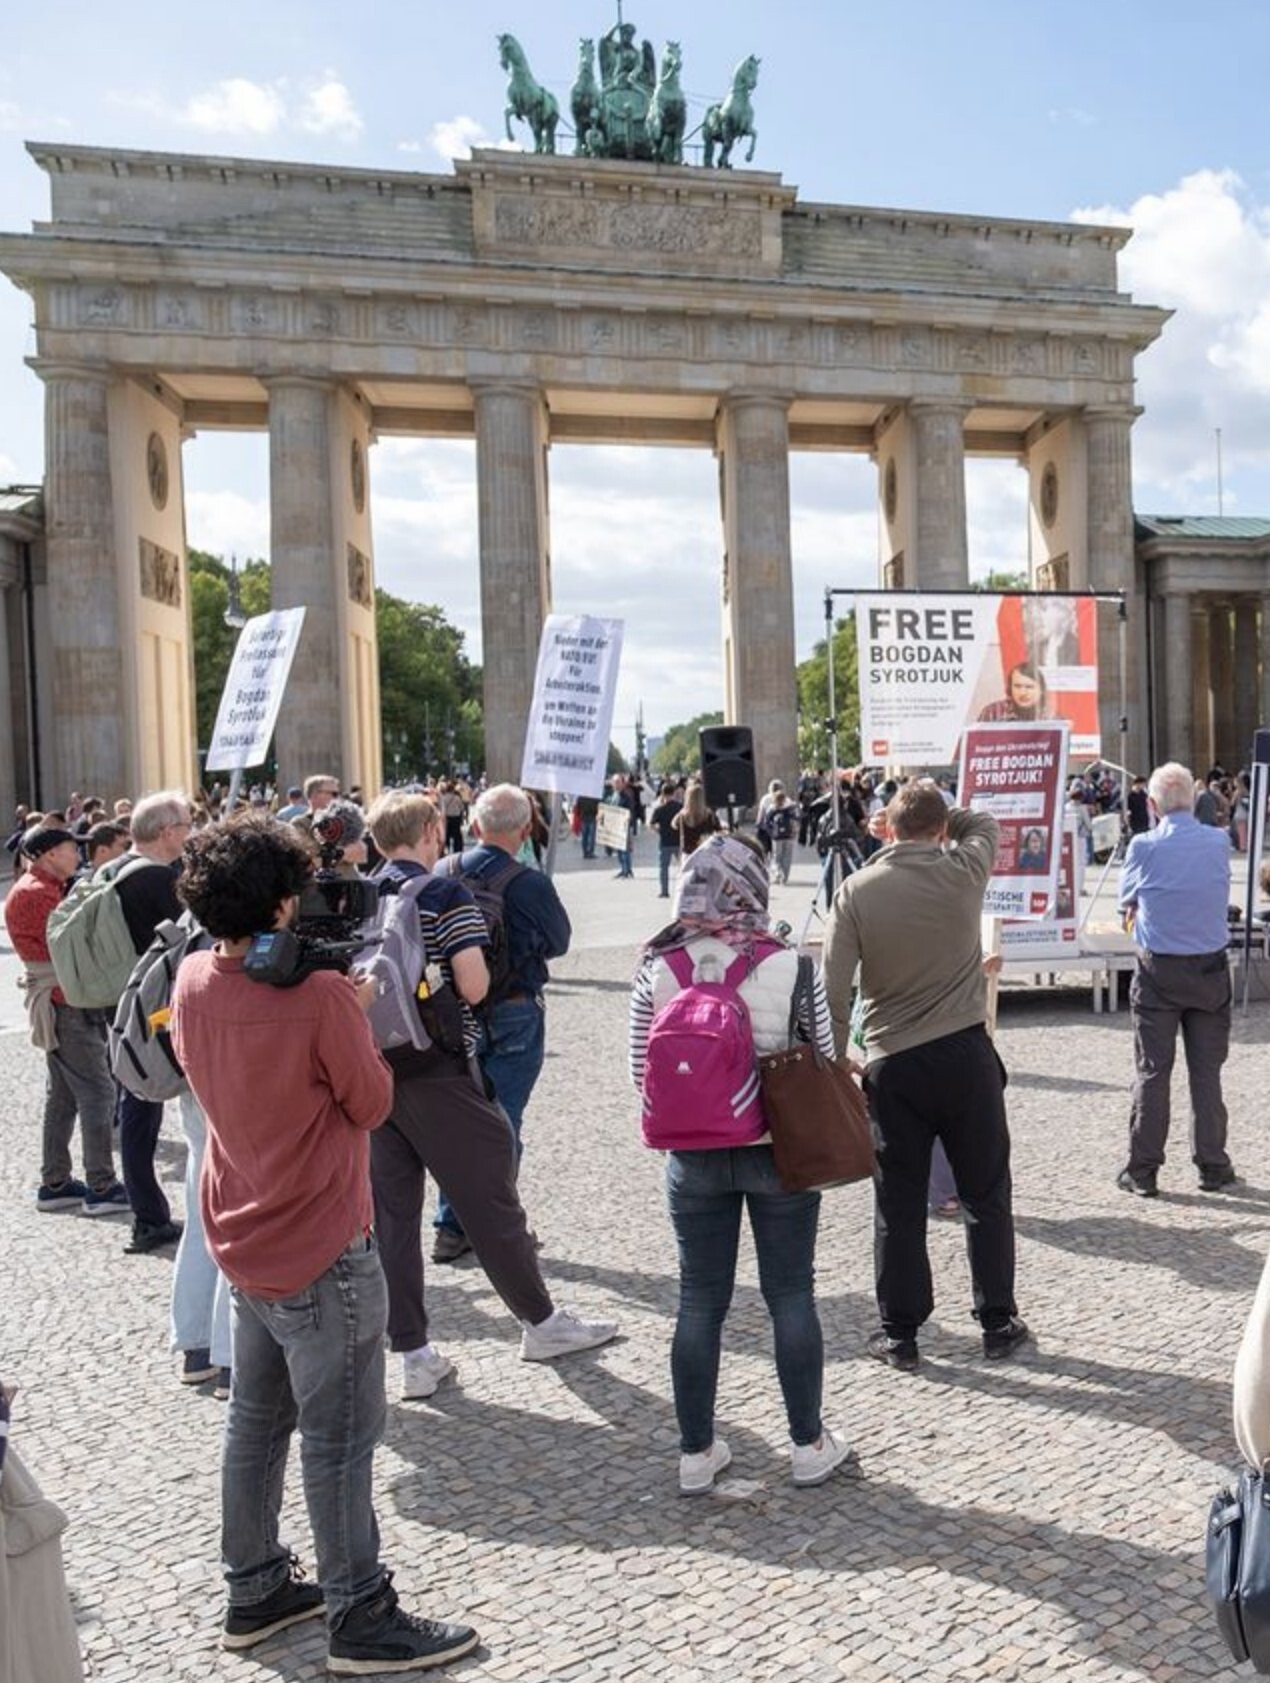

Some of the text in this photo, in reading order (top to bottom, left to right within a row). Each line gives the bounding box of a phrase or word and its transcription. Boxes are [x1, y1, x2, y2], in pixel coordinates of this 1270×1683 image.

[869, 608, 975, 640] FREE
[870, 645, 963, 664] BOGDAN
[870, 668, 964, 683] SYROTJUK
[970, 753, 1054, 772] FREE BOGDAN
[975, 770, 1043, 786] SYROTJUK!
